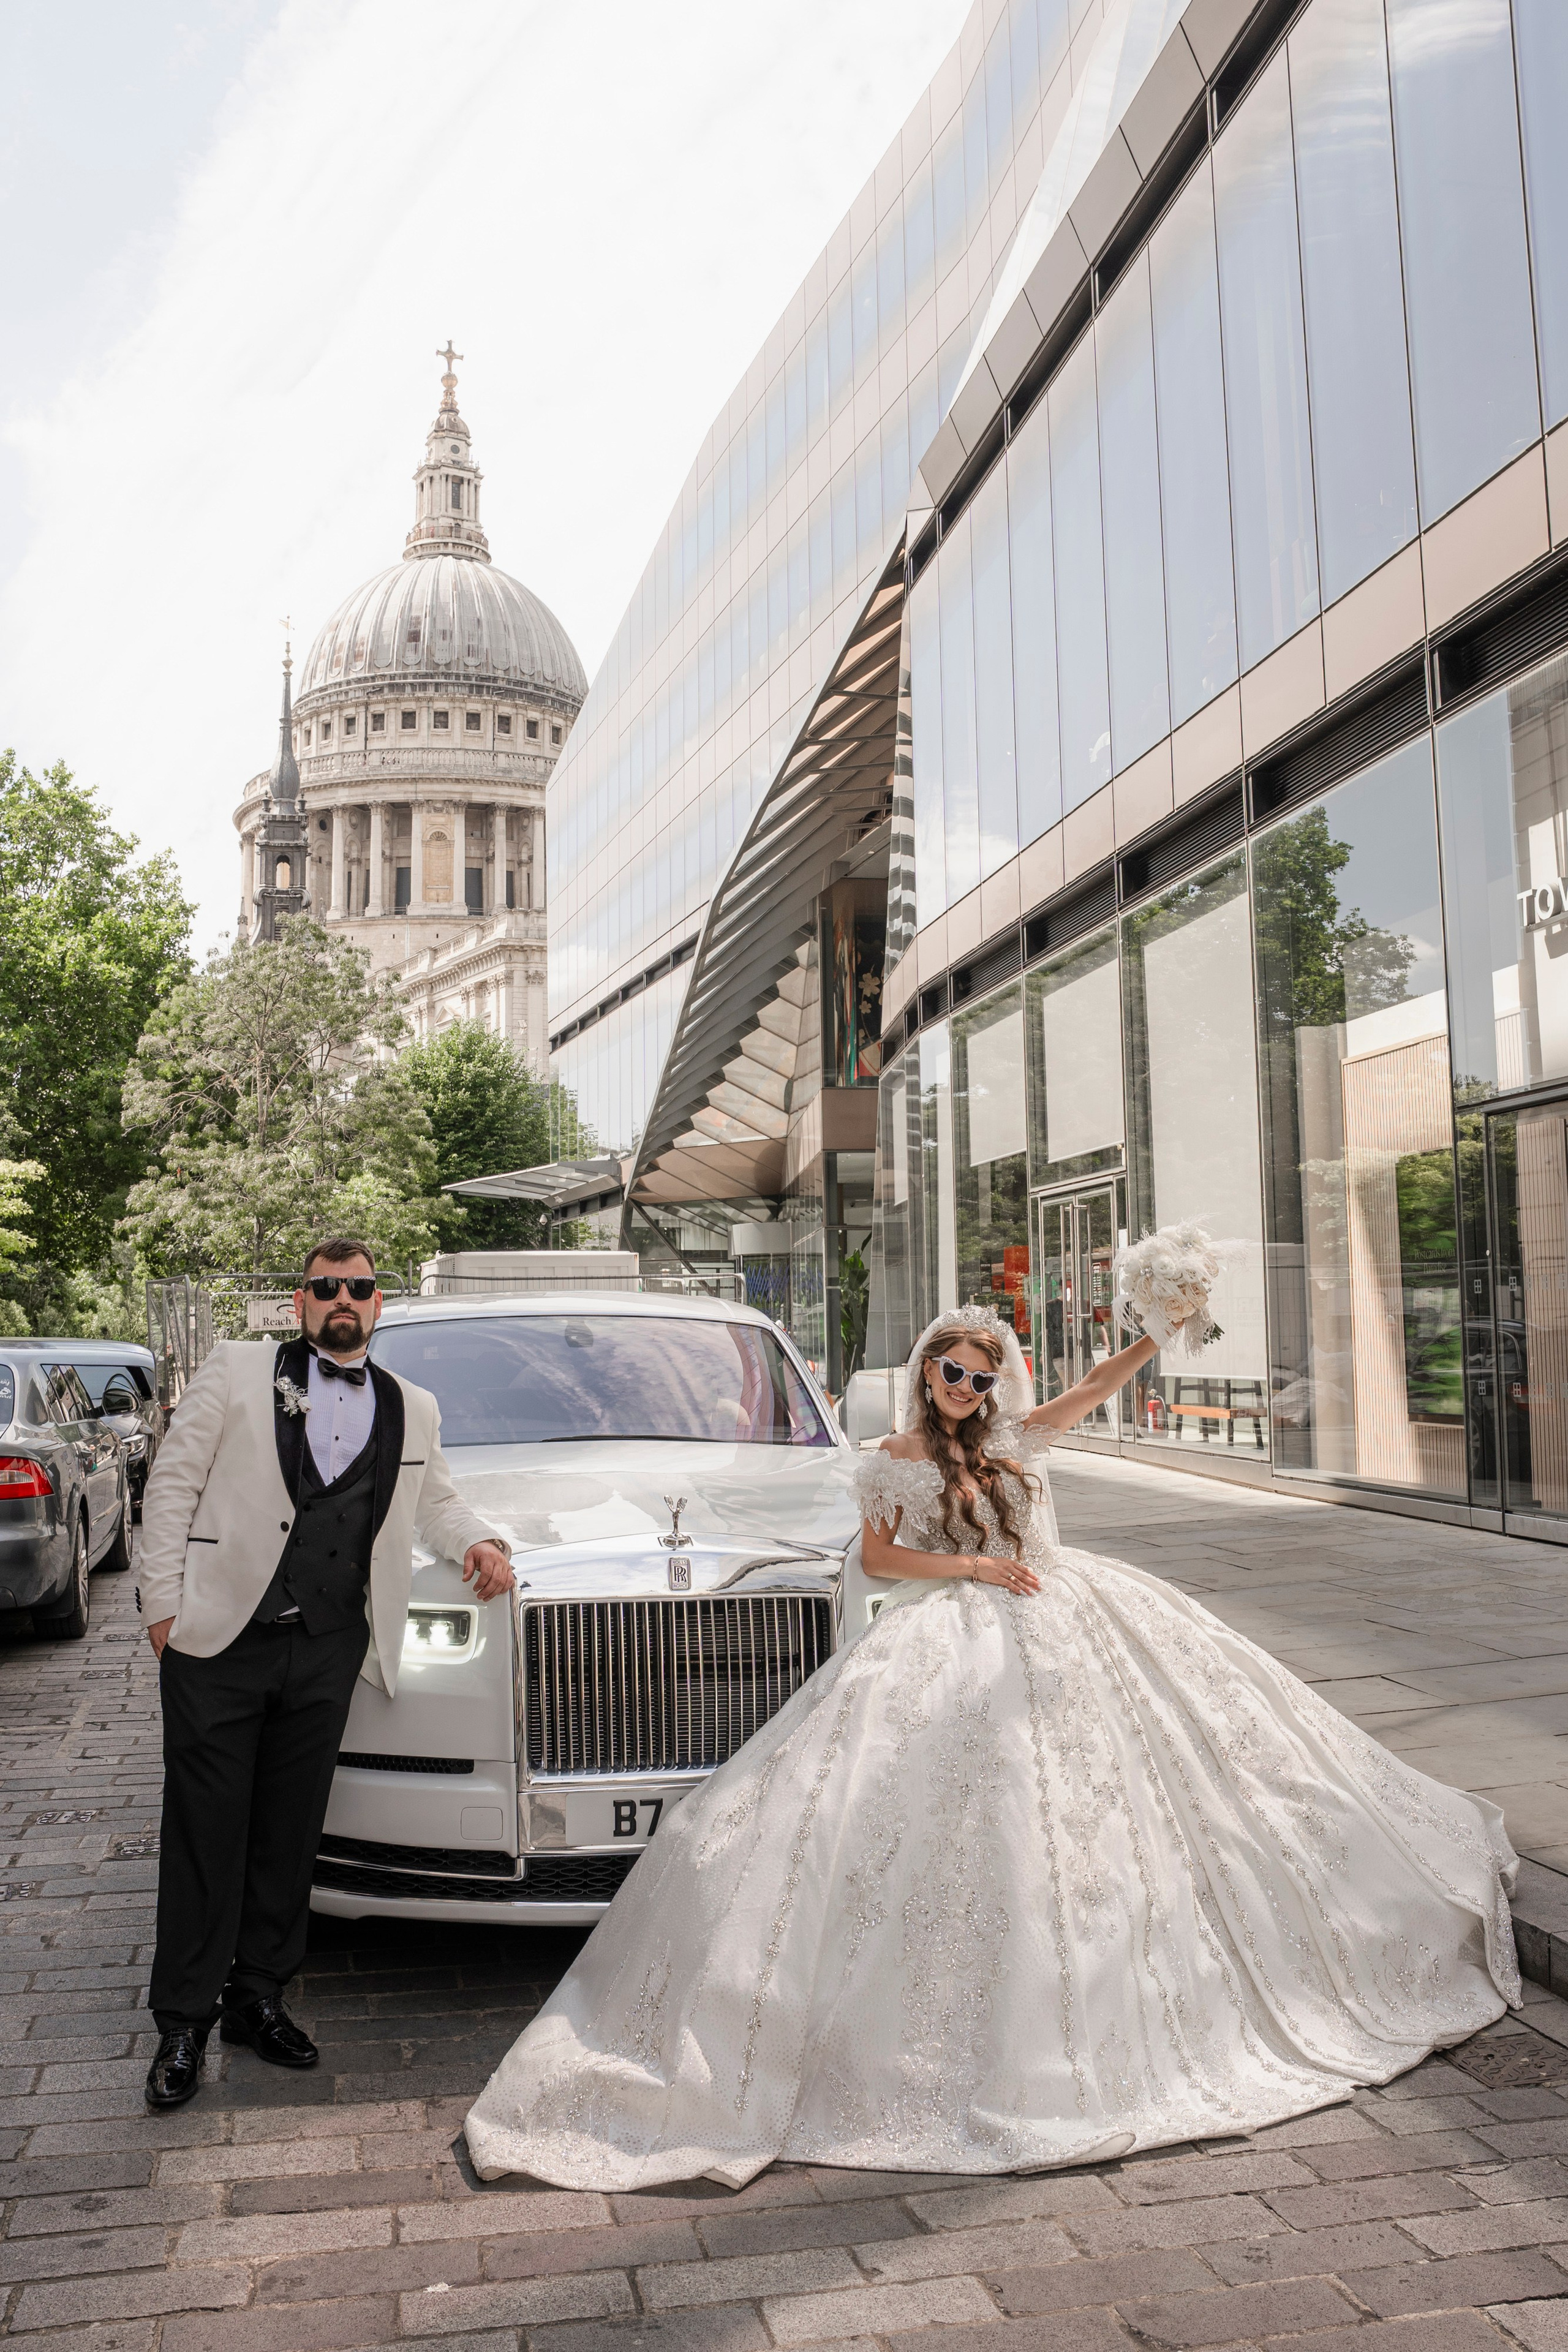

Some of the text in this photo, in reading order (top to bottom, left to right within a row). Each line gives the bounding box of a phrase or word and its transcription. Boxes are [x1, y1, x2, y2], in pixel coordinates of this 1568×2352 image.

[1414, 1247, 1440, 1261] Postcards
[263, 1316, 291, 1326] Reach
[613, 1798, 663, 1837] B7
